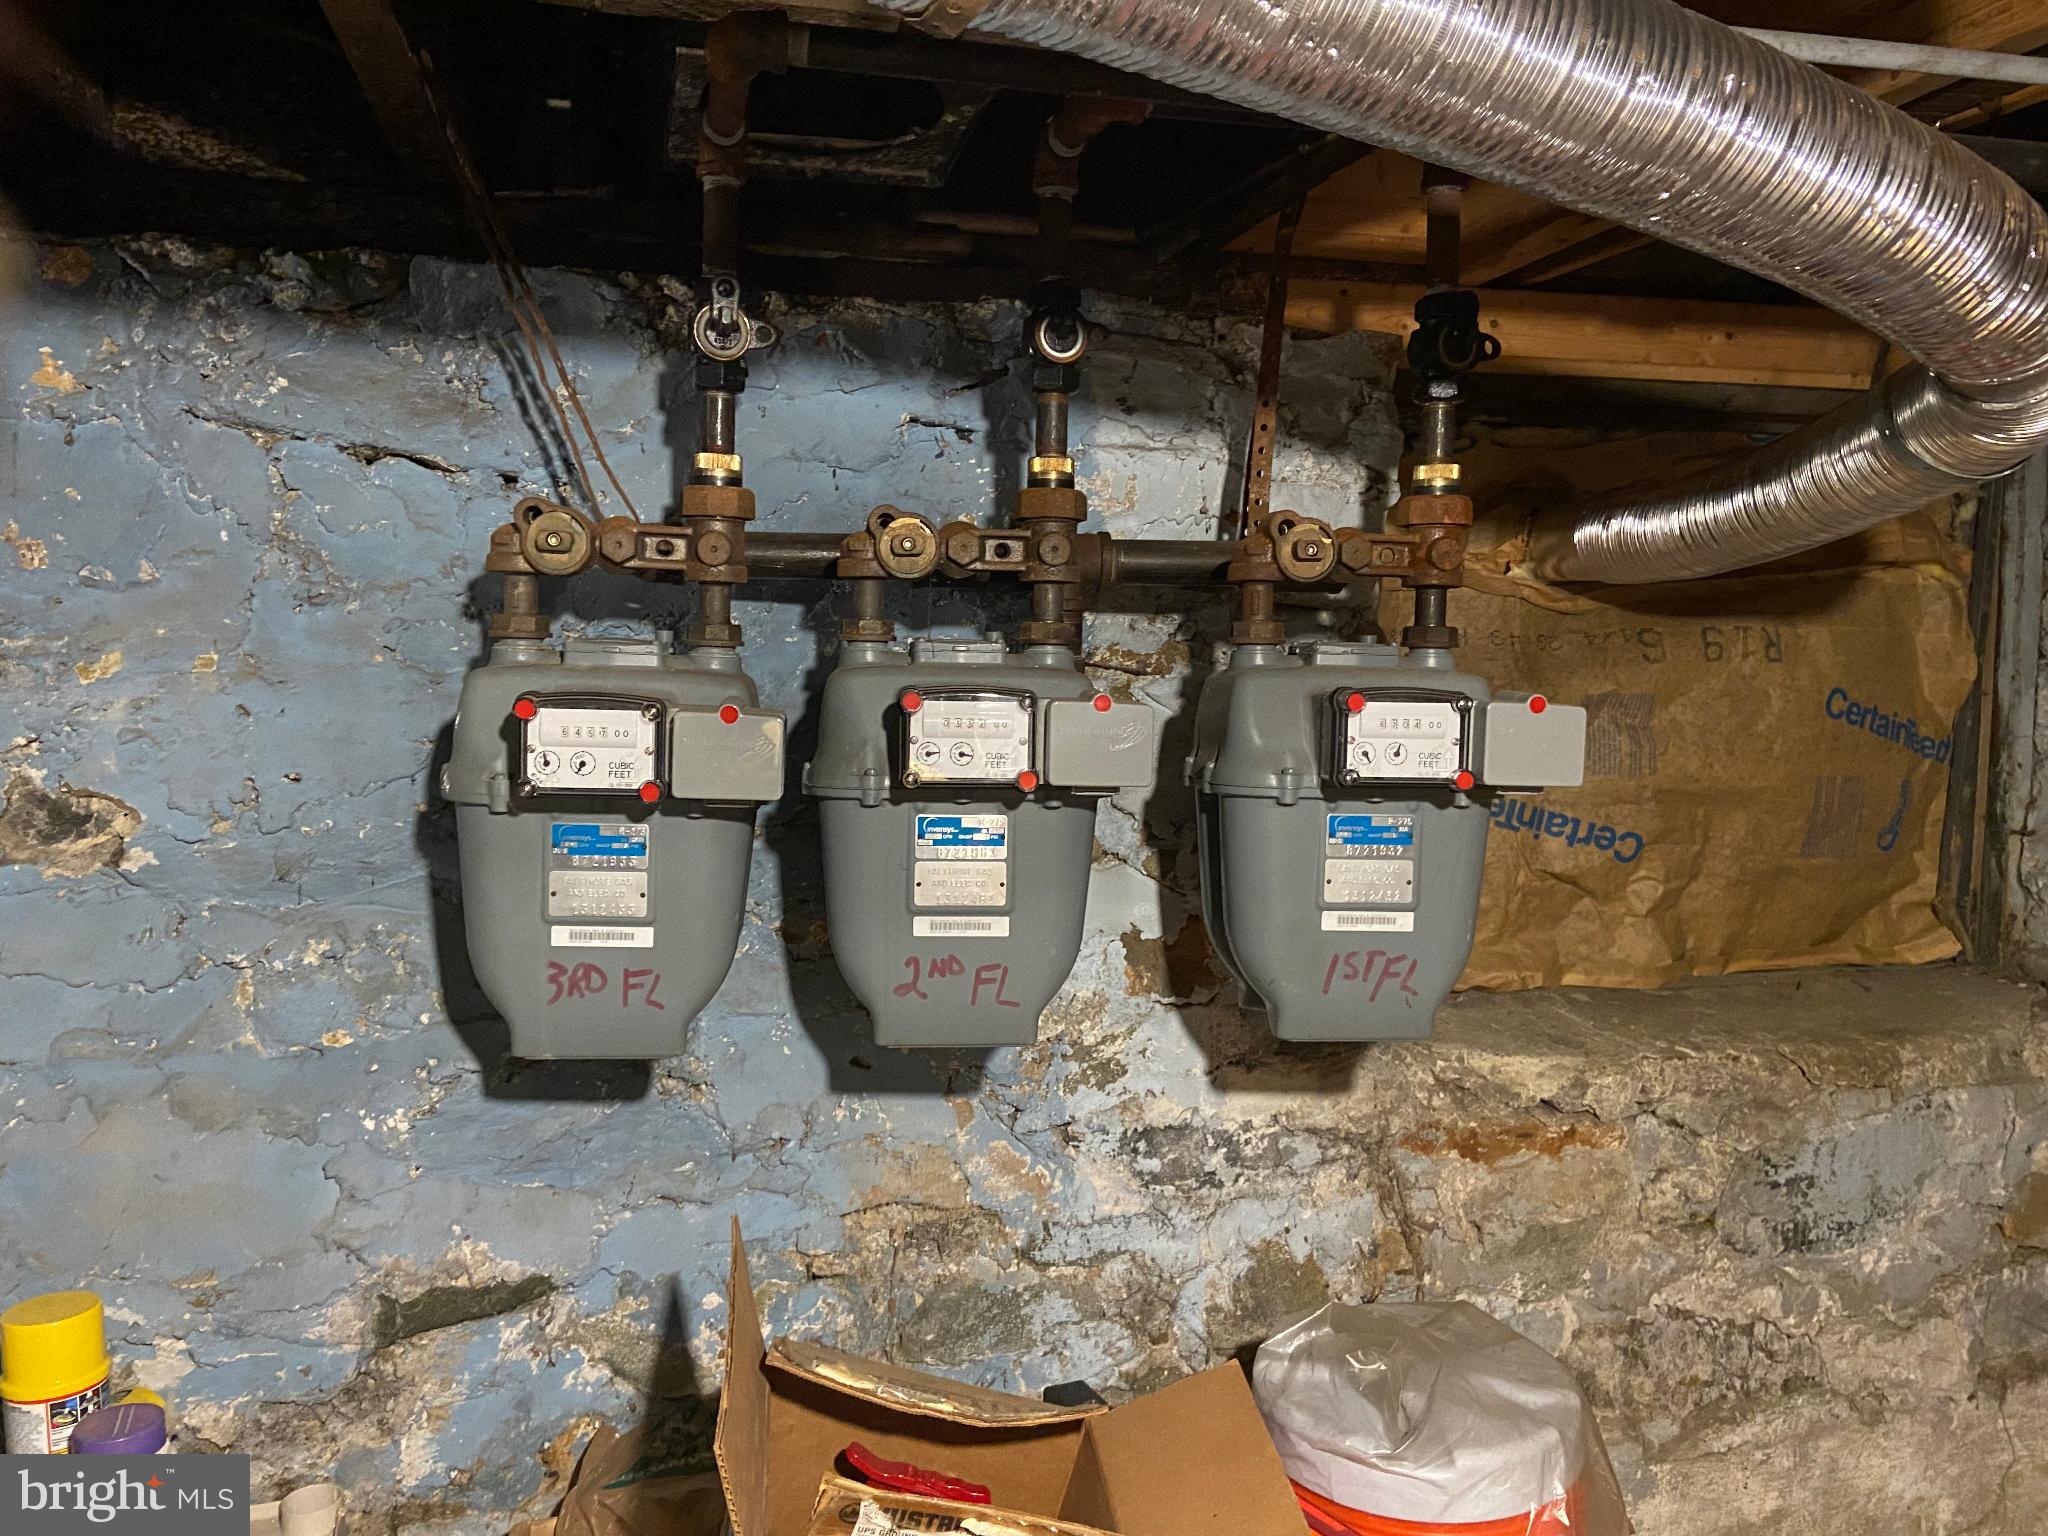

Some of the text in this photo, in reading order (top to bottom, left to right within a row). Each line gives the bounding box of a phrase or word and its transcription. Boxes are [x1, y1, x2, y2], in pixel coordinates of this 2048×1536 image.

[1699, 625, 1784, 663] R19
[1418, 753, 1442, 761] CUBIC
[608, 761, 635, 770] CUBIC
[985, 761, 1007, 769] FEET
[1418, 760, 1440, 769] FEET
[608, 770, 632, 779] FEET
[892, 952, 1021, 1008] 2ND FL
[1320, 948, 1420, 1003] 1ST FL
[545, 960, 667, 1011] 3RD FL
[857, 1525, 876, 1535] UPS
